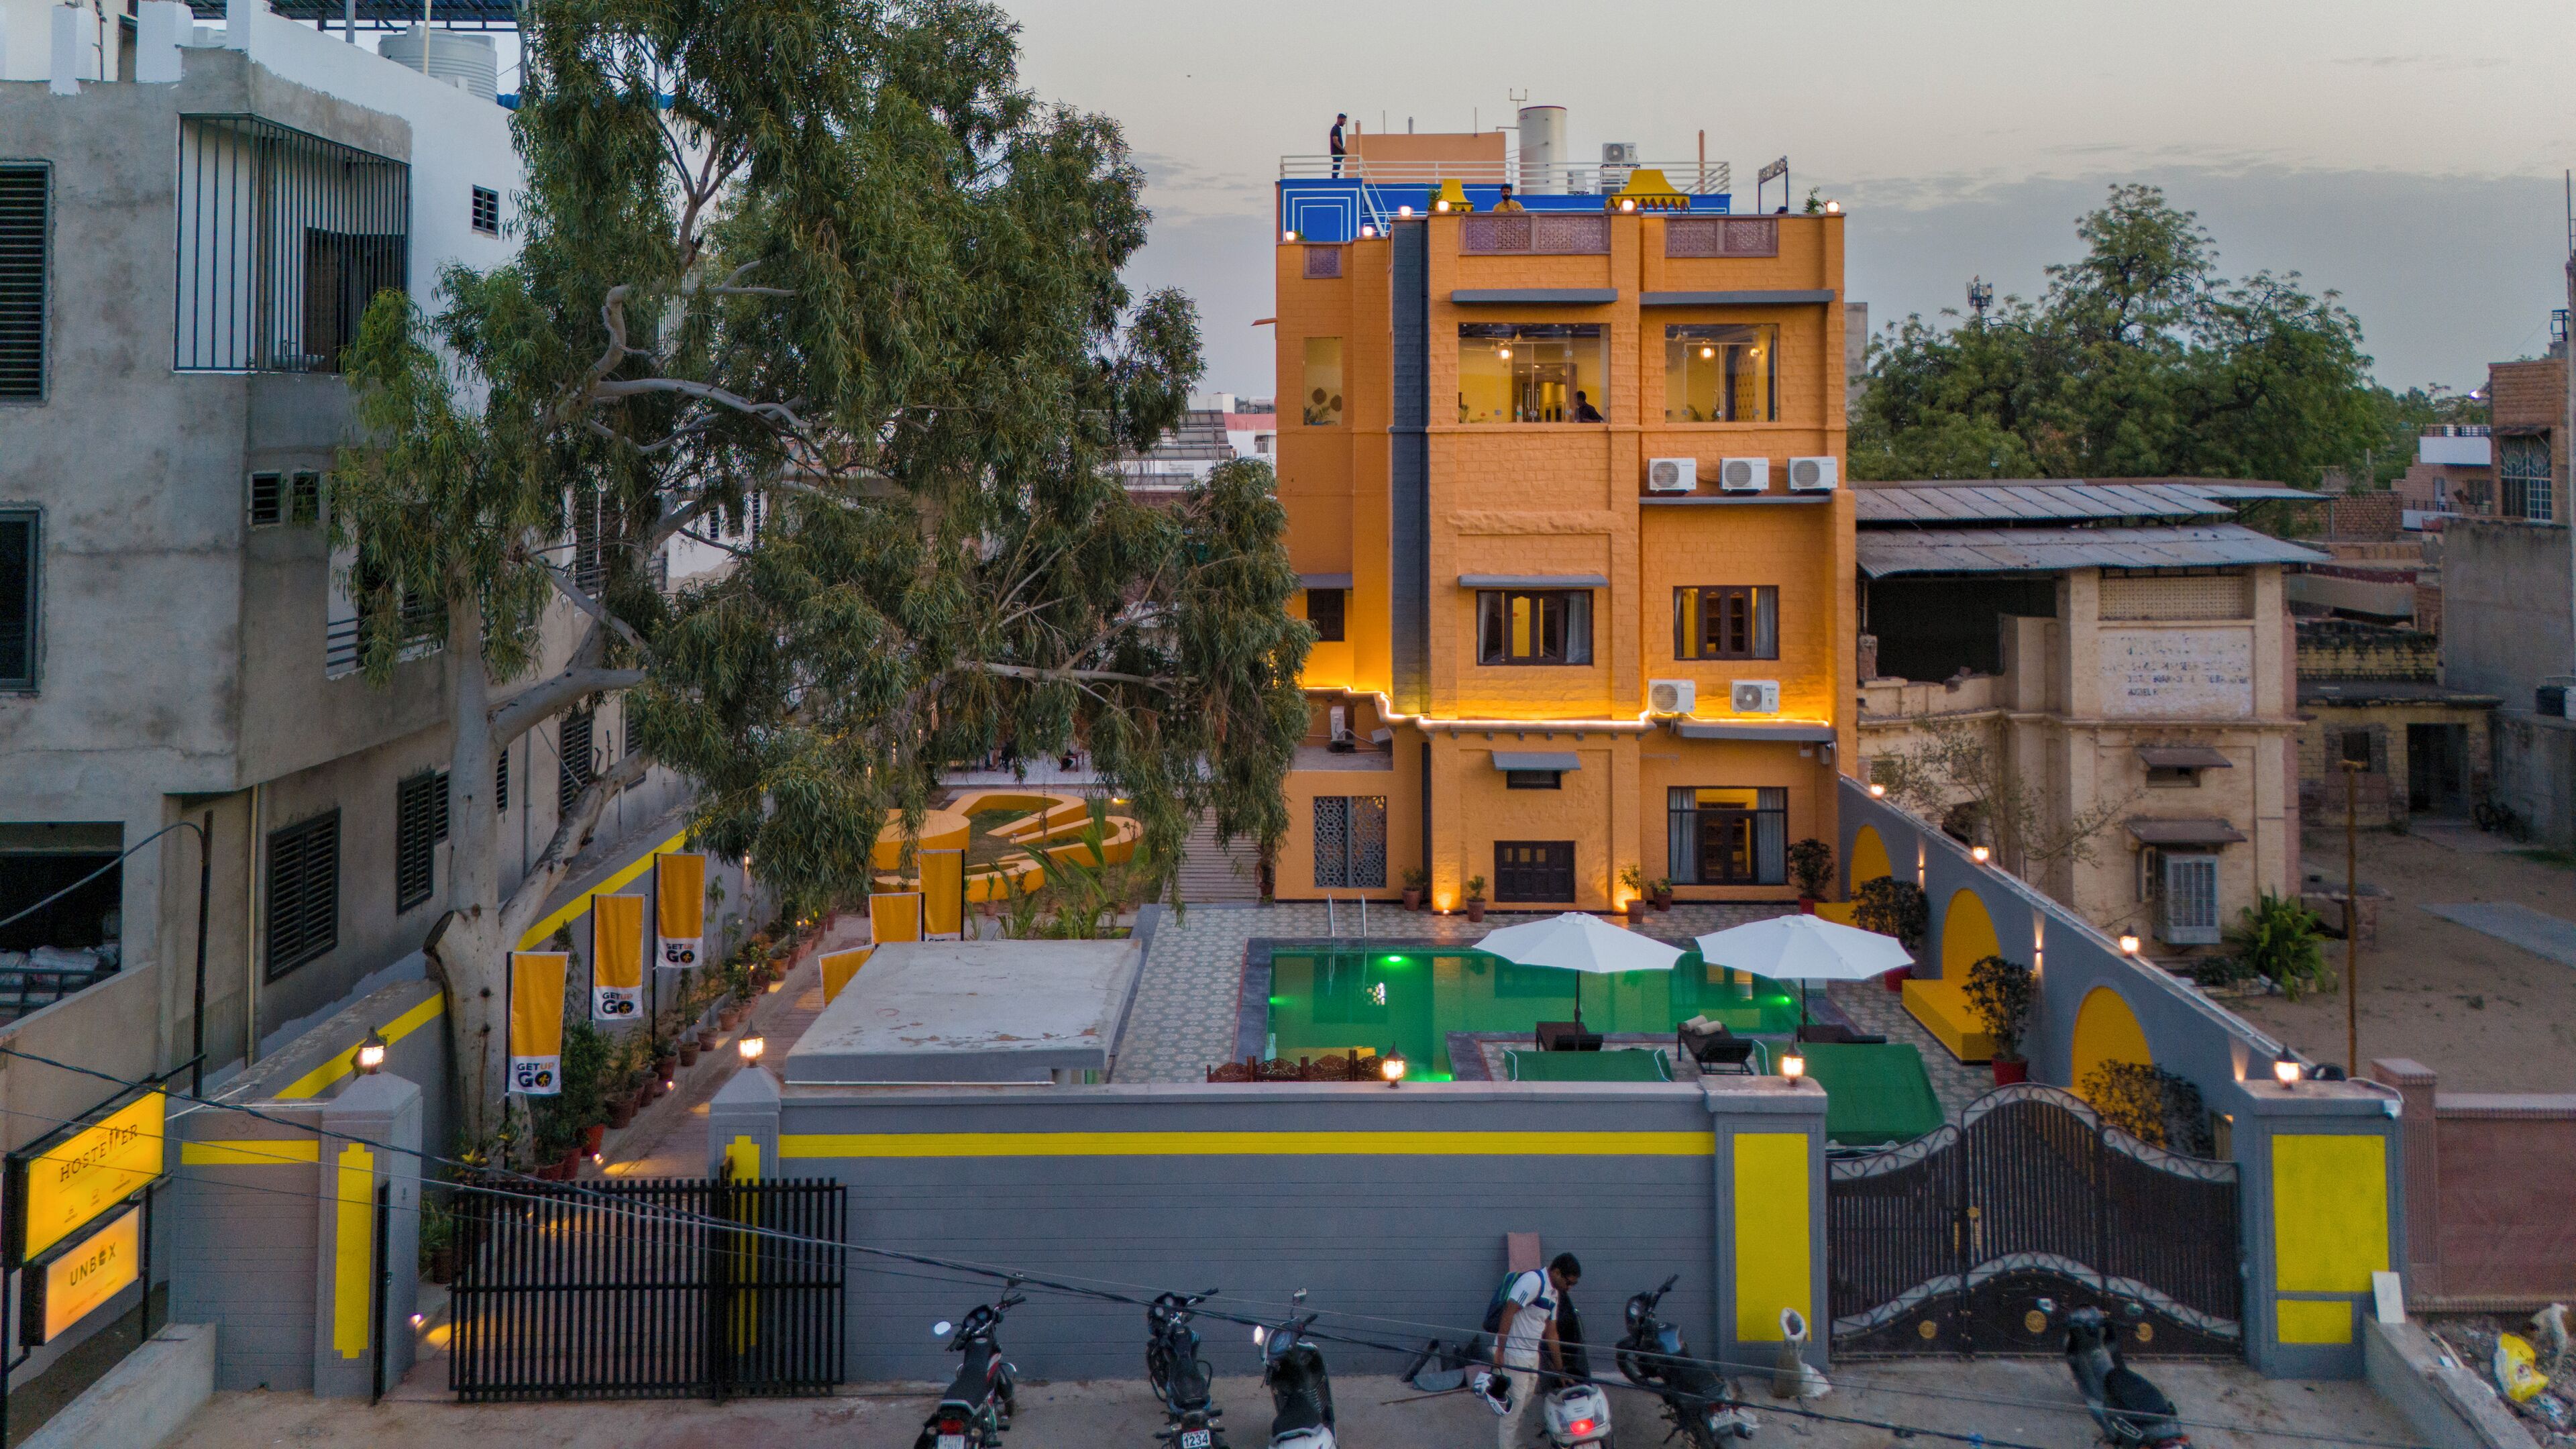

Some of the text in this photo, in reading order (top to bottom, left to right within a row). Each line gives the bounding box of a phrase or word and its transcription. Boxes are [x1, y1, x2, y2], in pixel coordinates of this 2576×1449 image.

[666, 949, 695, 963] GO
[602, 1000, 634, 1014] GO
[518, 1071, 553, 1087] GO
[1184, 1434, 1208, 1446] 1234
